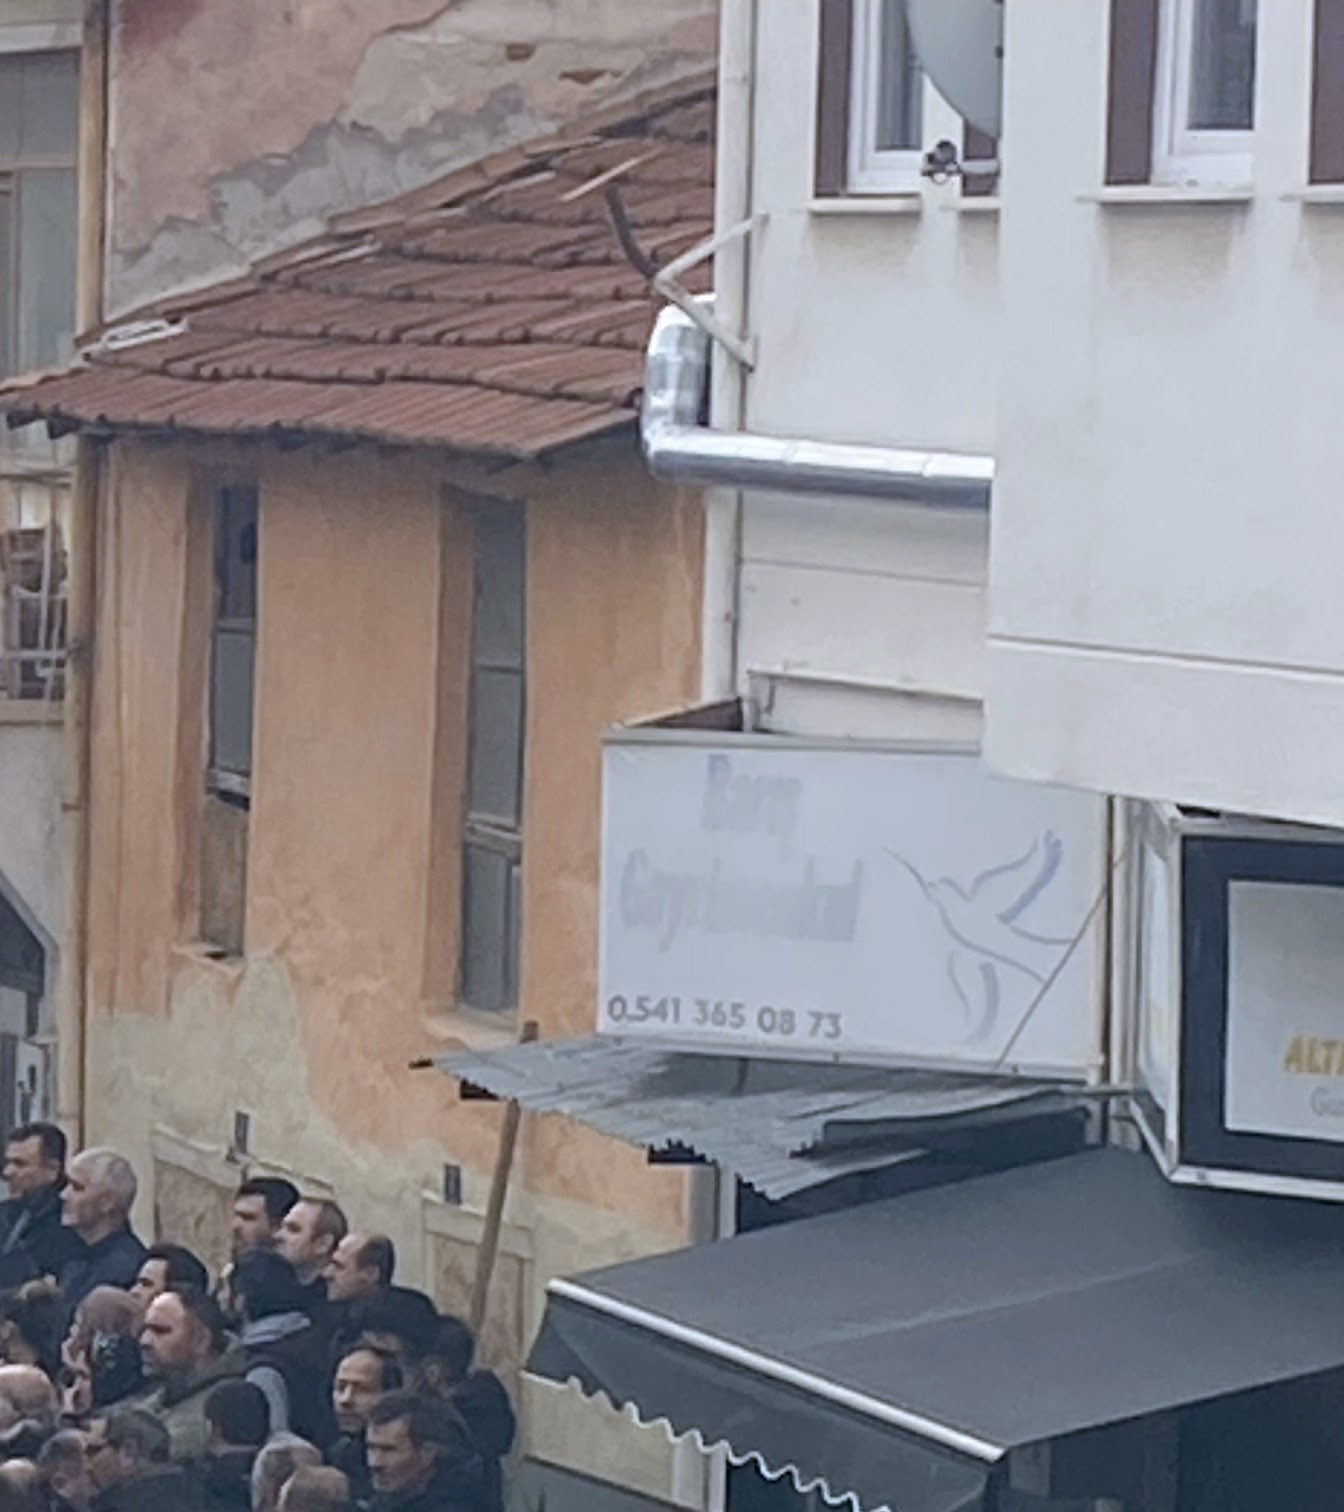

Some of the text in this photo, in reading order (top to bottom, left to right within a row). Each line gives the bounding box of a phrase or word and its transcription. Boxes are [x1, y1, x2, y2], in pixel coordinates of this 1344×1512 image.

[693, 999, 746, 1029] 365
[757, 1005, 797, 1036] 08
[809, 1011, 843, 1039] 73
